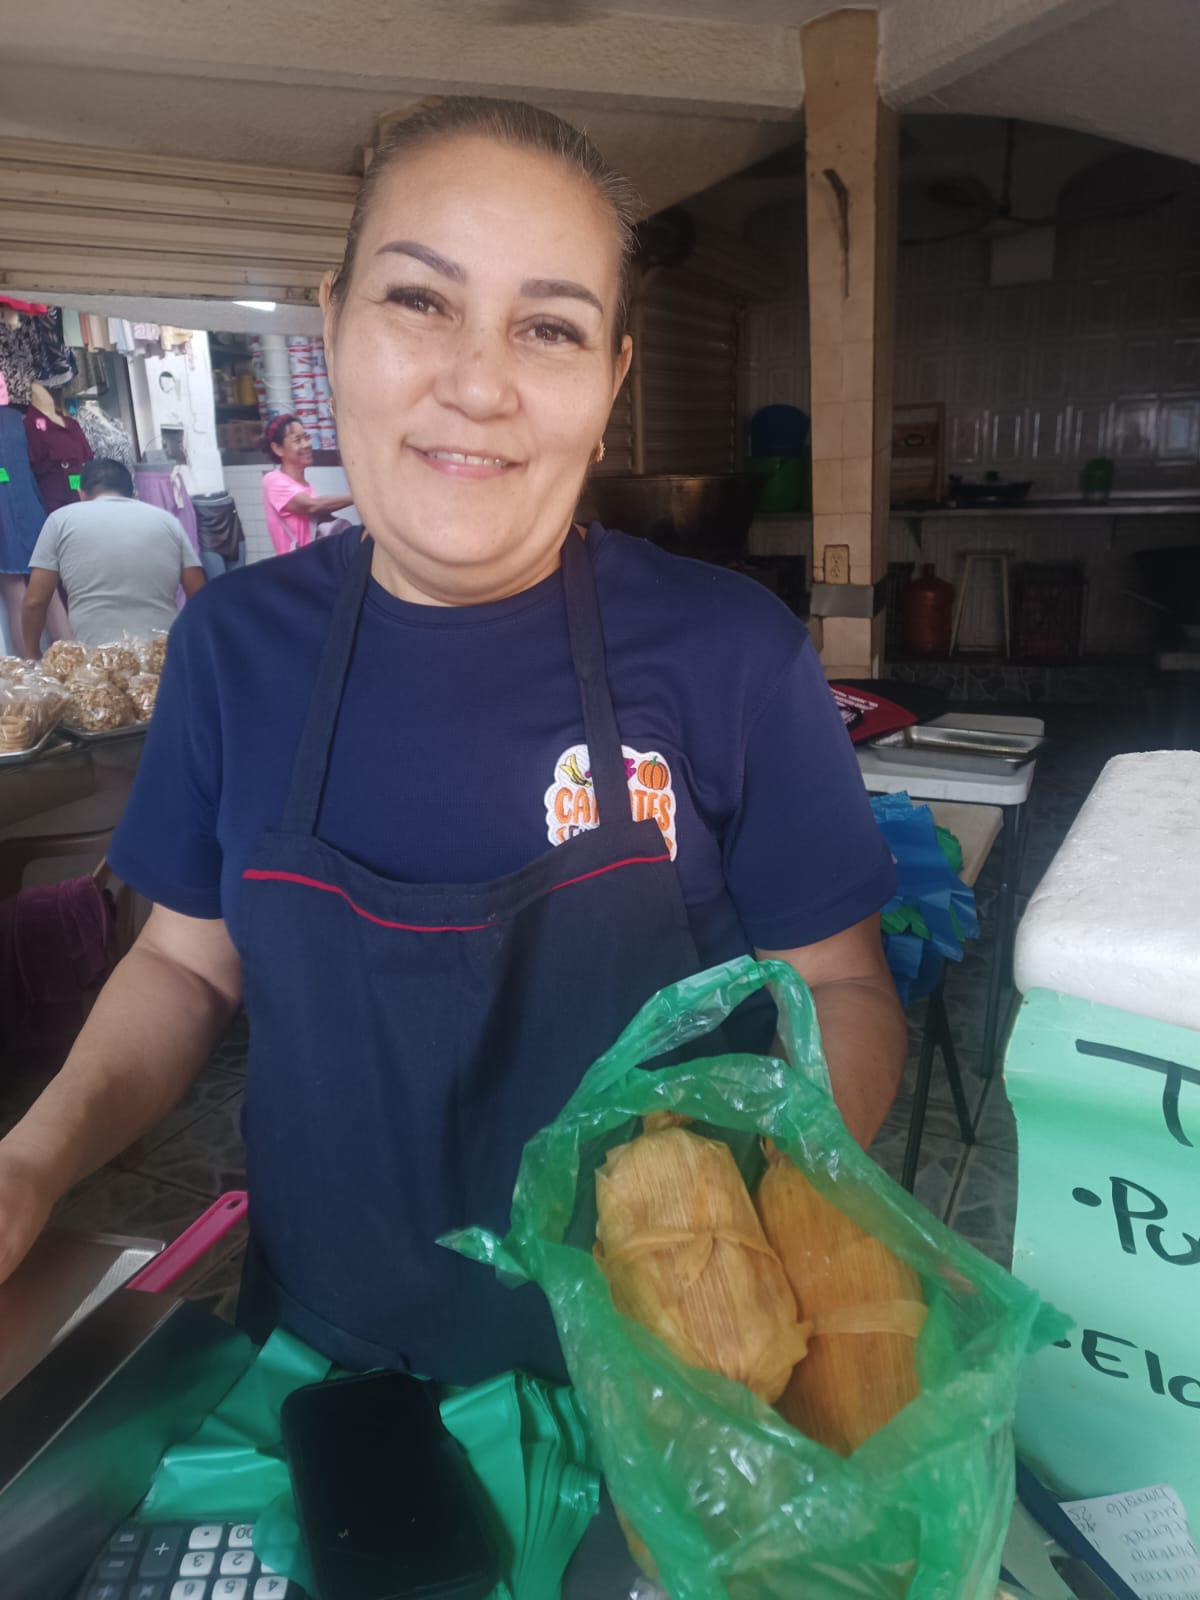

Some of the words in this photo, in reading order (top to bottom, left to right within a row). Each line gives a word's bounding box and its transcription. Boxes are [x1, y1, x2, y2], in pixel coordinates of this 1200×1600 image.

[1075, 1038, 1200, 1148] T
[193, 1554, 205, 1567] 3
[232, 1552, 245, 1566] 2
[224, 1580, 237, 1594] 5
[268, 1578, 279, 1593] 4
